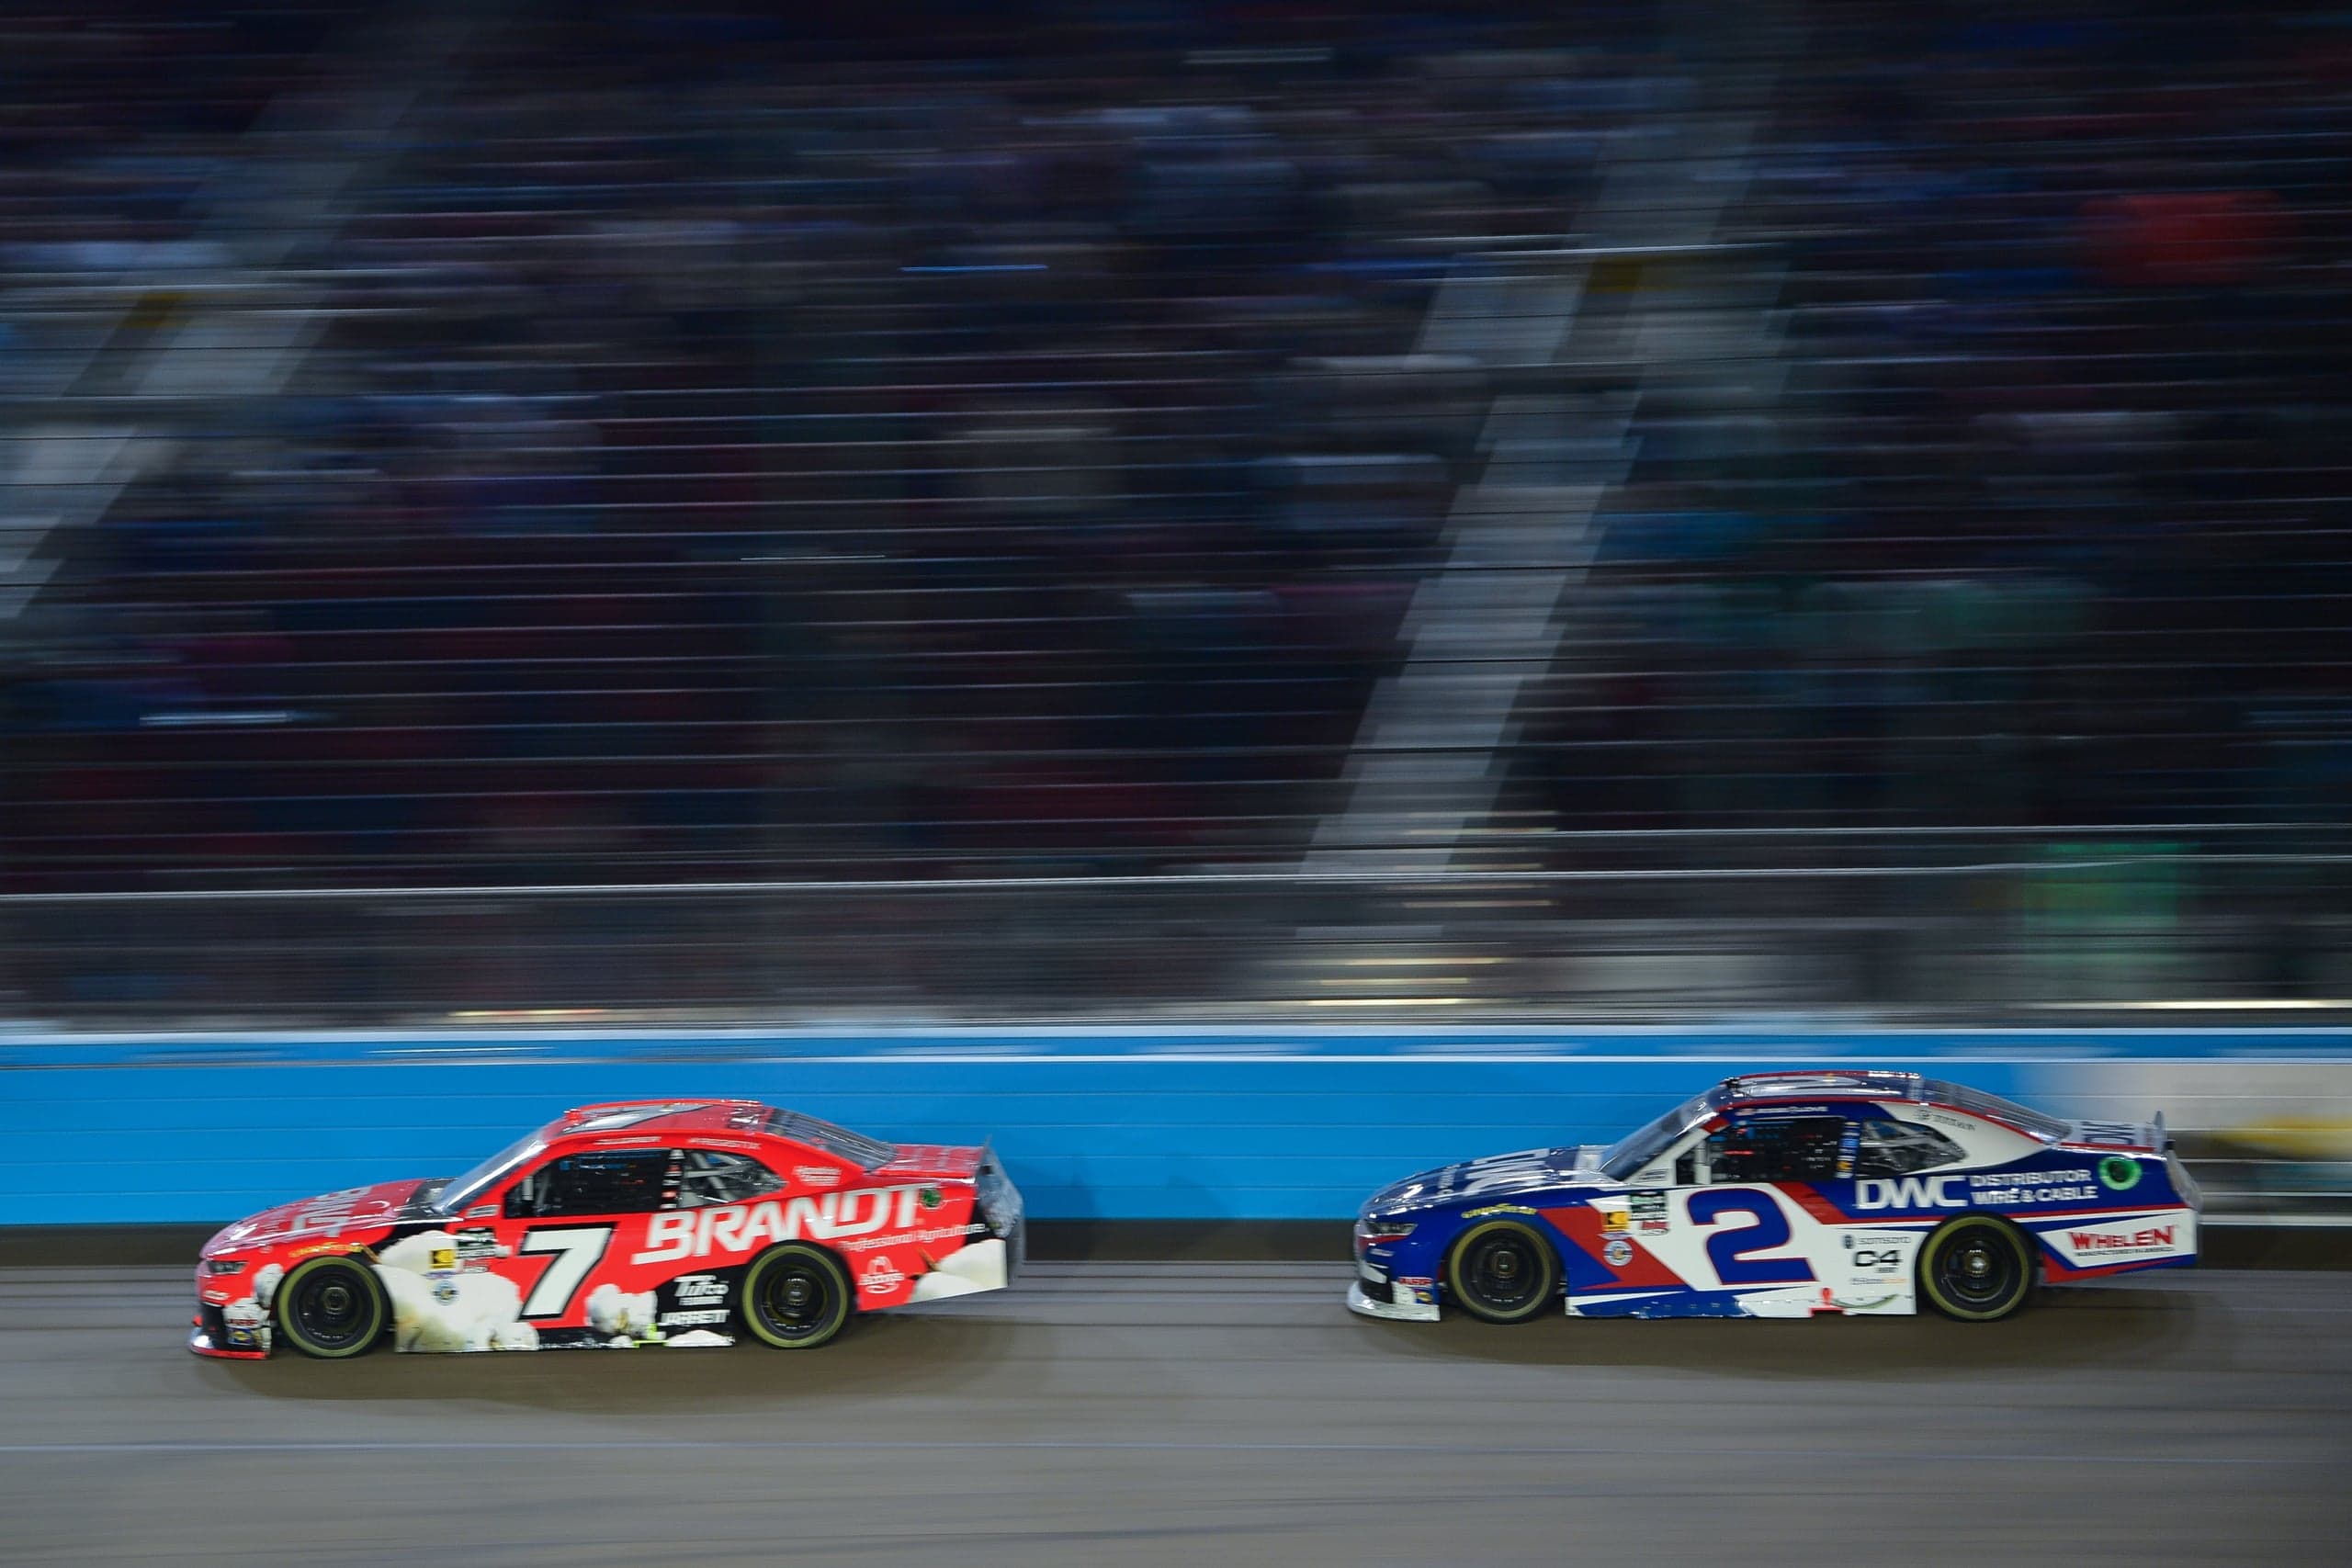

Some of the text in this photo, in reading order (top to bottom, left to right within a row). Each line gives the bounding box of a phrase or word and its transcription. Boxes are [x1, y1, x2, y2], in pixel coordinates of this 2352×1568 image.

[1856, 1176, 1968, 1209] DWC
[1970, 1169, 2091, 1187] DISTRIBUTOR
[1972, 1186, 2098, 1204] WIRE & CABLE
[631, 1182, 937, 1265] BRANDT
[1687, 1188, 1819, 1285] 2
[2069, 1224, 2175, 1250] WHELEN
[519, 1223, 616, 1321] 7
[1853, 1250, 1905, 1267] C4
